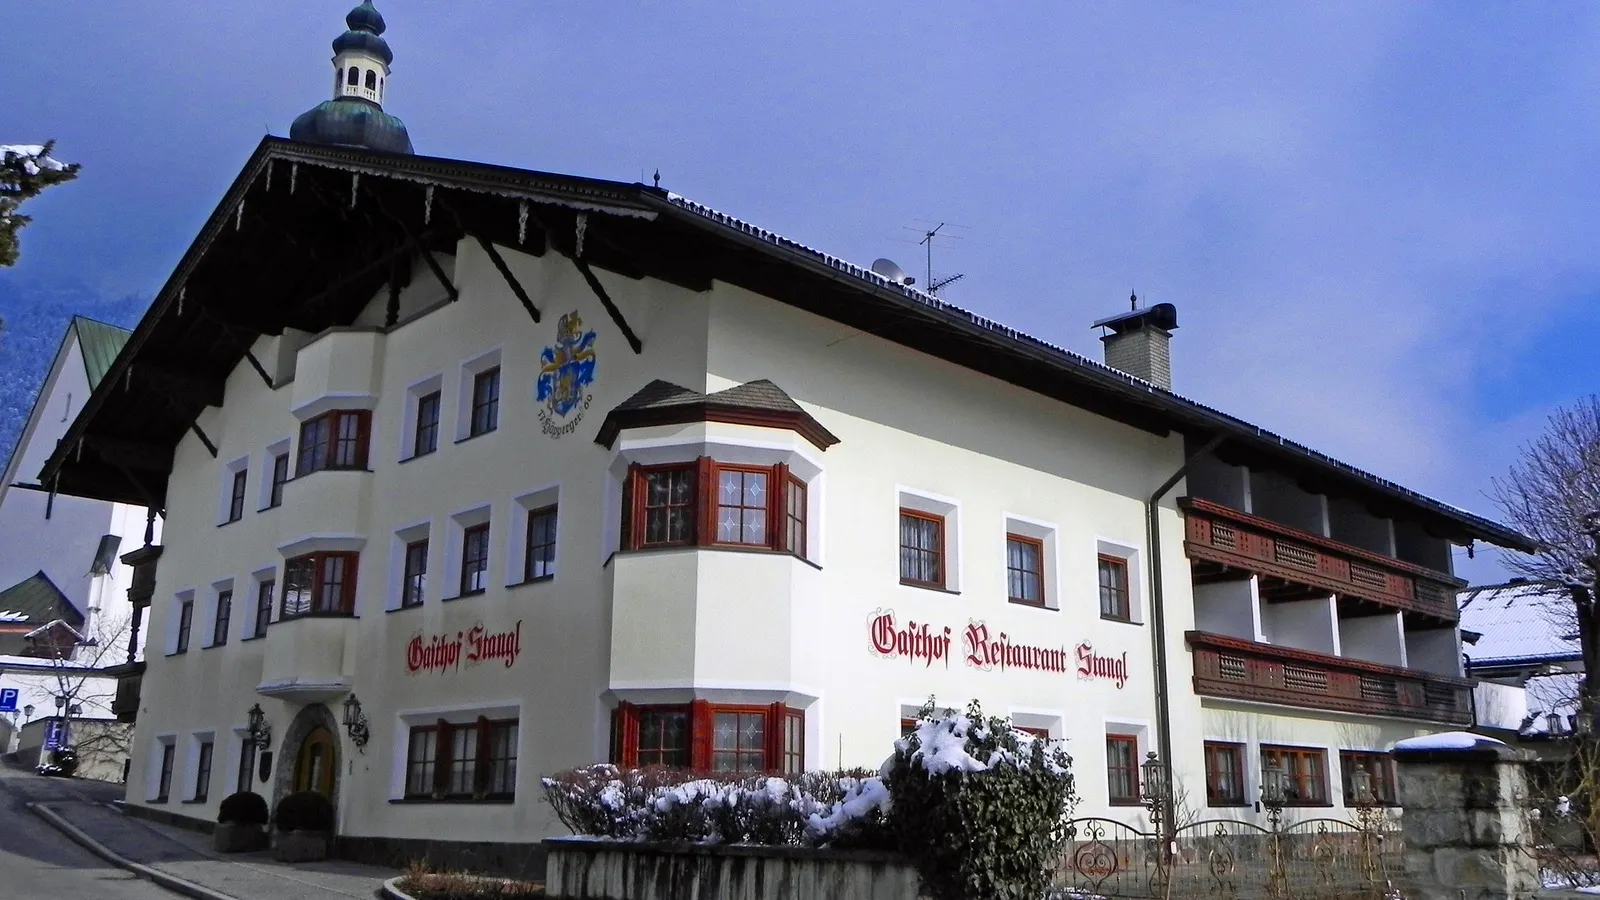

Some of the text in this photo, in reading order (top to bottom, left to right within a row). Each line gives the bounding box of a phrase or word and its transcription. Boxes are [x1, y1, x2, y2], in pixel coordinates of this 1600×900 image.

[407, 620, 522, 675] Gasthof Stangl
[869, 610, 1129, 689] Gasthof Restaurant Stangl
[3, 690, 16, 703] P
